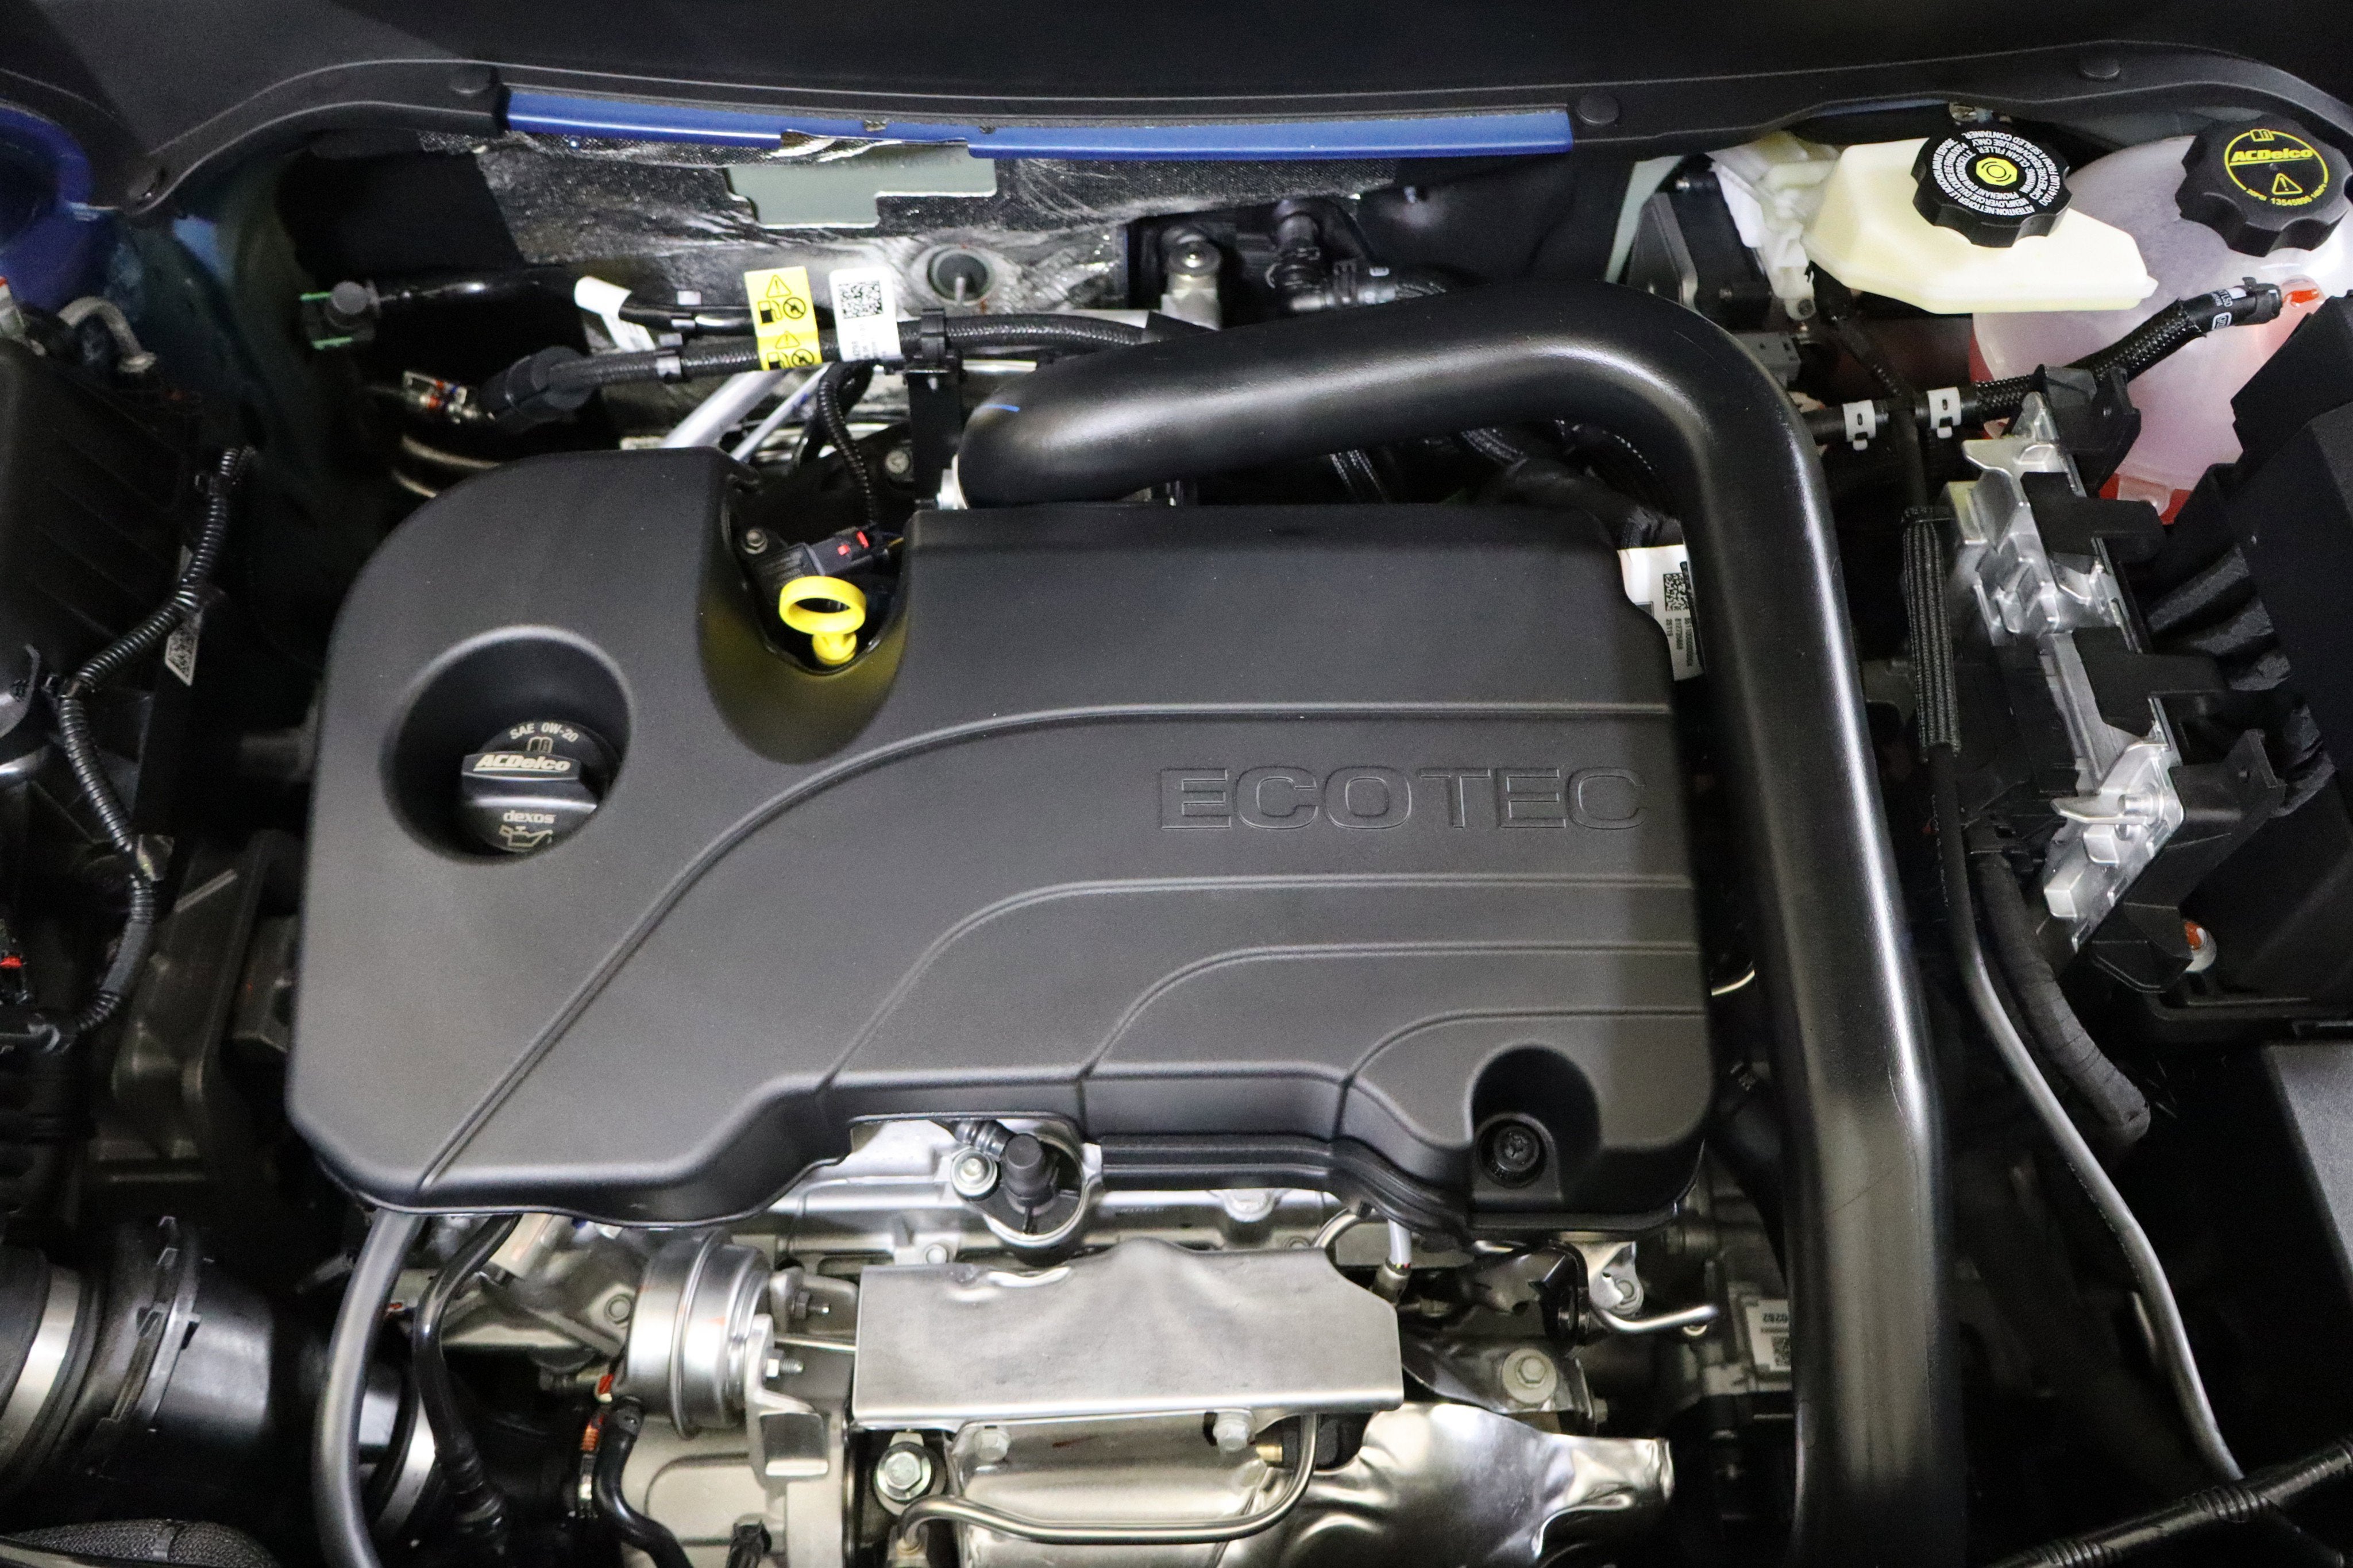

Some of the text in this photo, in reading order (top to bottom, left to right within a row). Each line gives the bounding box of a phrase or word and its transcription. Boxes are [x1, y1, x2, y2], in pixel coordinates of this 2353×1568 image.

[1972, 138, 1993, 147] ONLY
[1976, 145, 2006, 155] FILLER
[1993, 138, 2011, 148] USE
[2012, 137, 2043, 155] SEALED
[2005, 150, 2031, 167] CLEAN
[2231, 148, 2313, 162] ACDelco
[2042, 157, 2059, 175] FROM
[2036, 167, 2049, 190] BEFORE
[2048, 175, 2061, 193] FLUID
[1969, 193, 1986, 204] QUE
[1975, 188, 2020, 200] PROVENANT
[2029, 187, 2043, 200] CAP
[1958, 196, 1995, 214] NETTOYER
[510, 722, 579, 743] SAE 0W-20
[475, 754, 571, 771] ACDelco
[1160, 766, 1647, 830] ECOTEC
[503, 810, 555, 824] dexos
